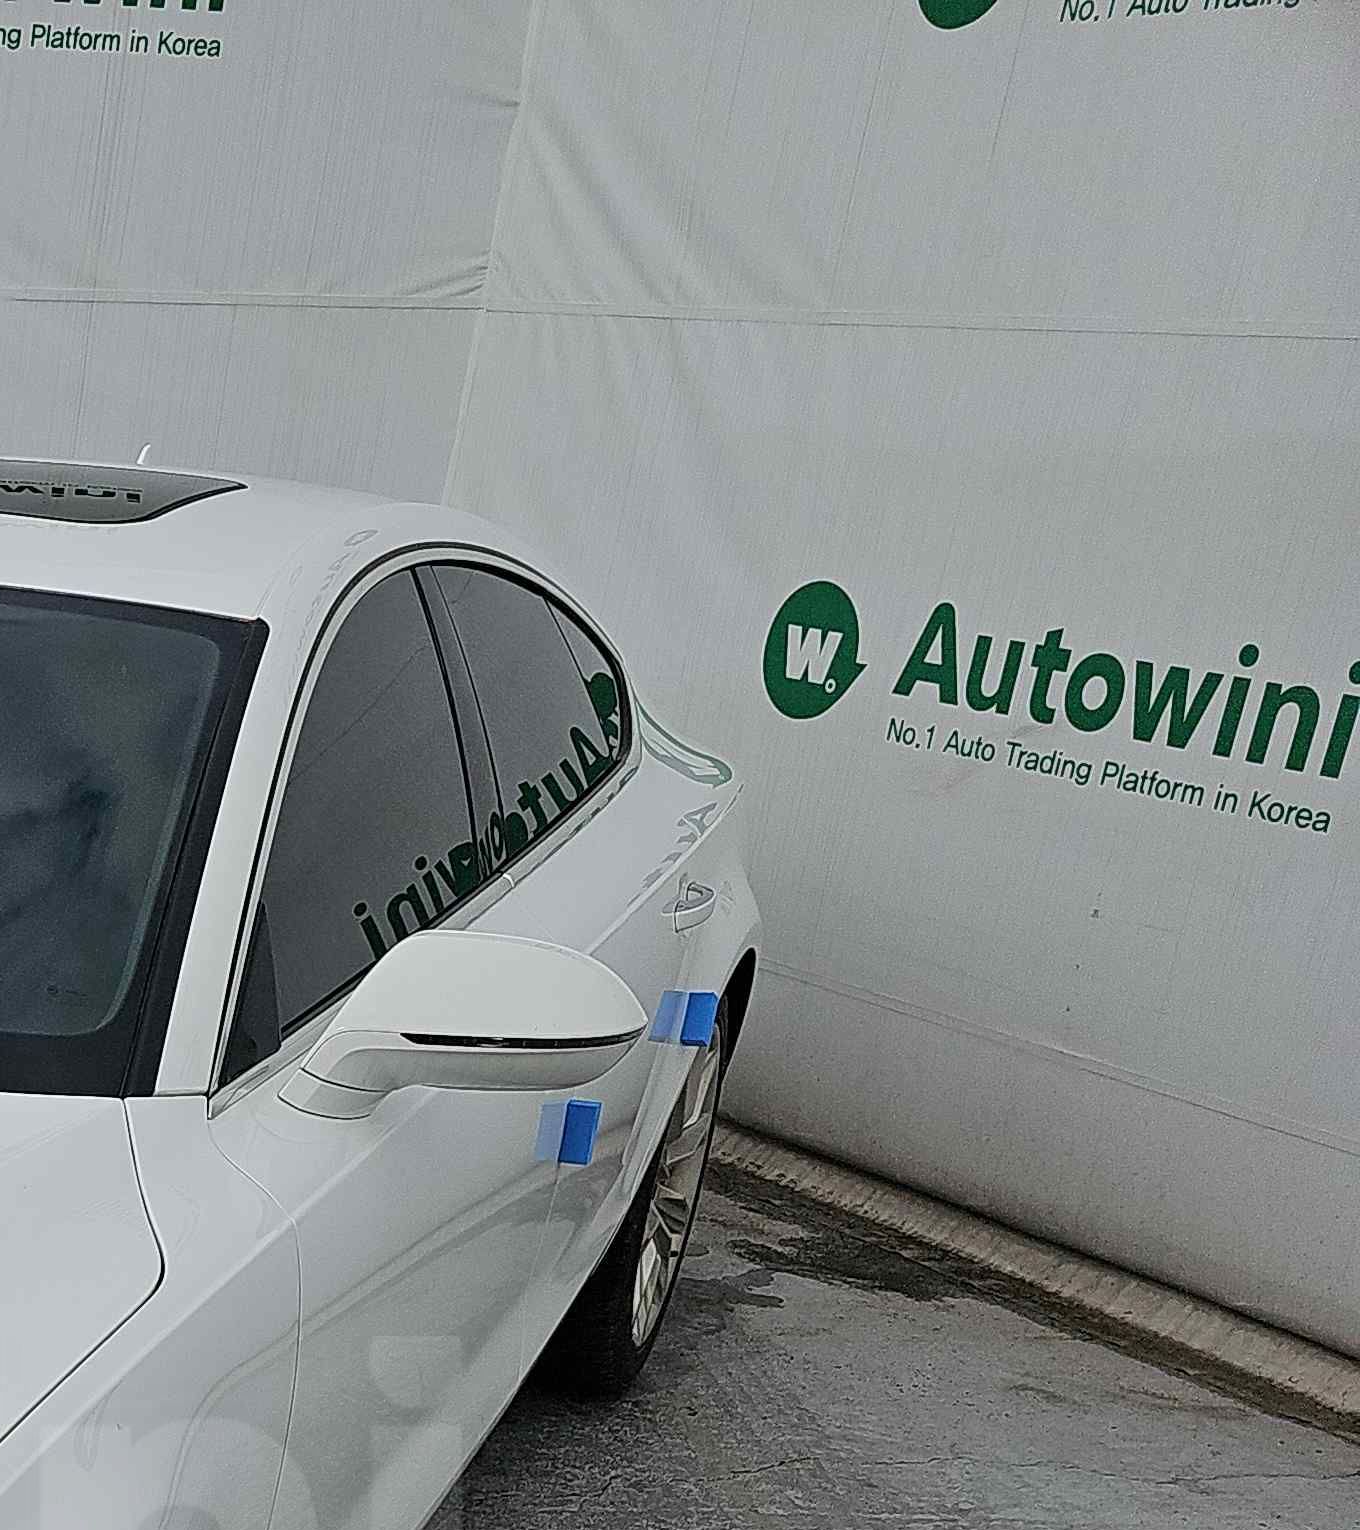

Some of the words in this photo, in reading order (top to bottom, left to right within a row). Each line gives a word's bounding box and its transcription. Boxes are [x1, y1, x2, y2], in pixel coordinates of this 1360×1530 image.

[31, 23, 121, 53] Platform
[130, 30, 149, 55] in
[158, 31, 221, 58] Korea
[1060, 0, 1116, 22] No.1
[891, 601, 1360, 781] Autowini
[886, 717, 937, 752] No.1
[942, 728, 996, 763] Auto
[1006, 739, 1093, 787] Trading
[1100, 759, 1205, 808] Platform
[1213, 784, 1239, 815] in
[1247, 790, 1331, 835] Korea
